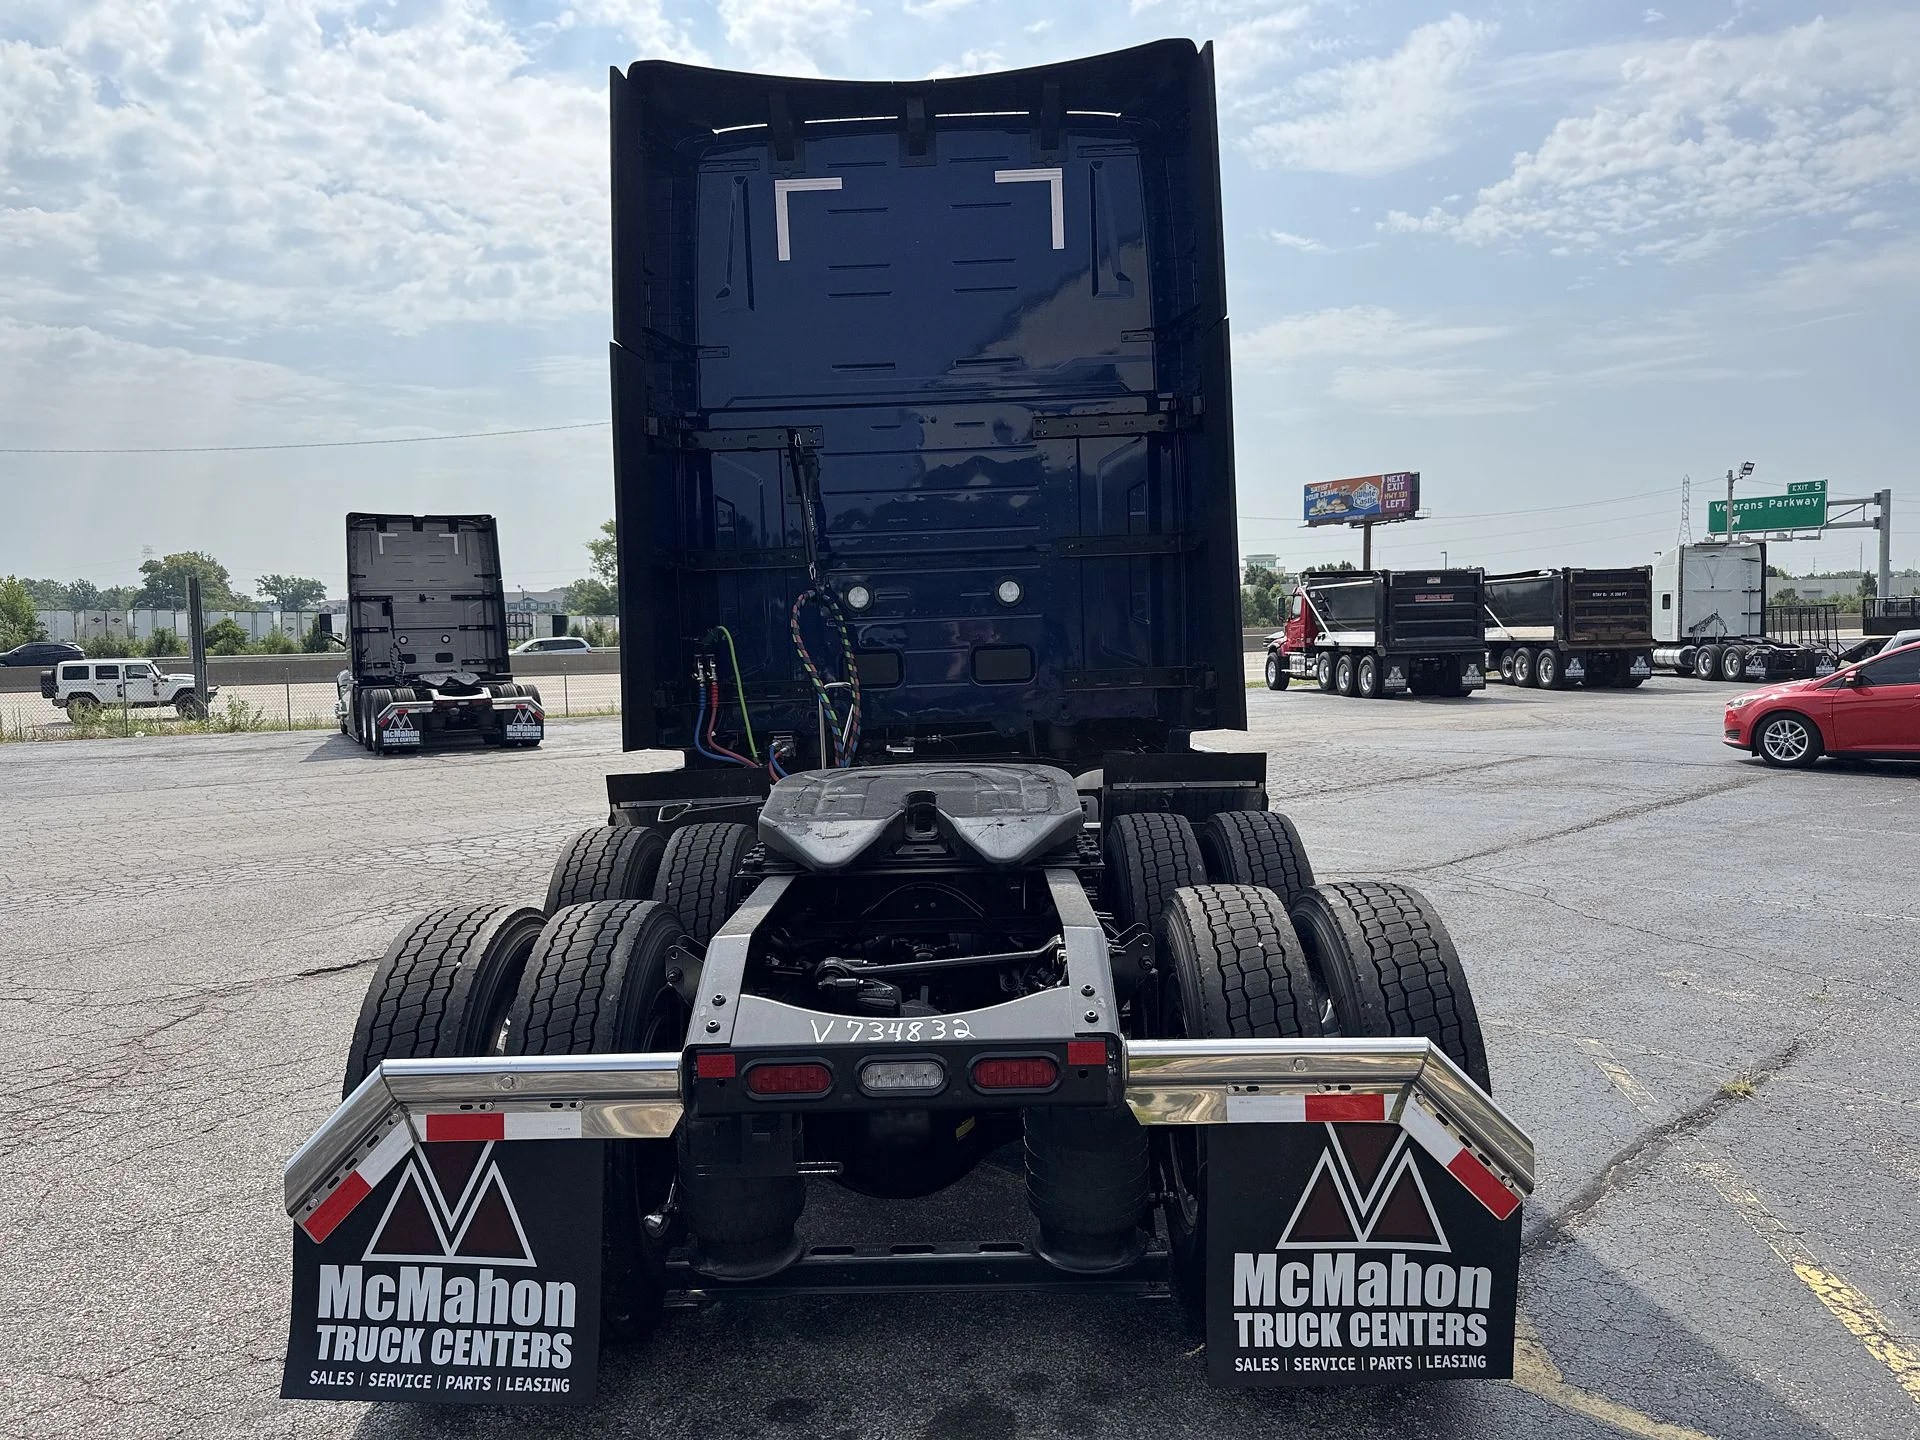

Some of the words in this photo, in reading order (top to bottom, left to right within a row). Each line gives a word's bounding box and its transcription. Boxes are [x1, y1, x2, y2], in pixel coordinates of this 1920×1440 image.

[1387, 474, 1405, 483] NEXT
[1310, 483, 1333, 494] SATISFY
[1387, 482, 1405, 491] EXIT
[1792, 484, 1809, 492] EXIT
[1814, 482, 1822, 491] 5
[1386, 499, 1406, 508] LEFT
[1715, 501, 1764, 512] Veerans
[1769, 497, 1819, 508] Parkway
[383, 730, 420, 738] McMahon
[506, 724, 542, 732] McMahon
[810, 1019, 835, 1044] V
[846, 1018, 977, 1043] 734832
[1233, 1252, 1492, 1309] McMahon
[317, 1264, 576, 1328] McMahon
[1233, 1312, 1342, 1348] TRUCK
[1349, 1312, 1488, 1348] CENTERS
[316, 1324, 425, 1364] TRUCK
[430, 1328, 573, 1369] CENTERS
[1234, 1357, 1280, 1372] SALES
[1293, 1356, 1356, 1371] SERVICE
[1369, 1355, 1413, 1370] PARTS
[1425, 1354, 1487, 1369] LEASING
[309, 1369, 355, 1386] SALES
[368, 1372, 432, 1389] SERVICE
[445, 1375, 492, 1391] PARTS
[505, 1376, 571, 1393] LEASING
